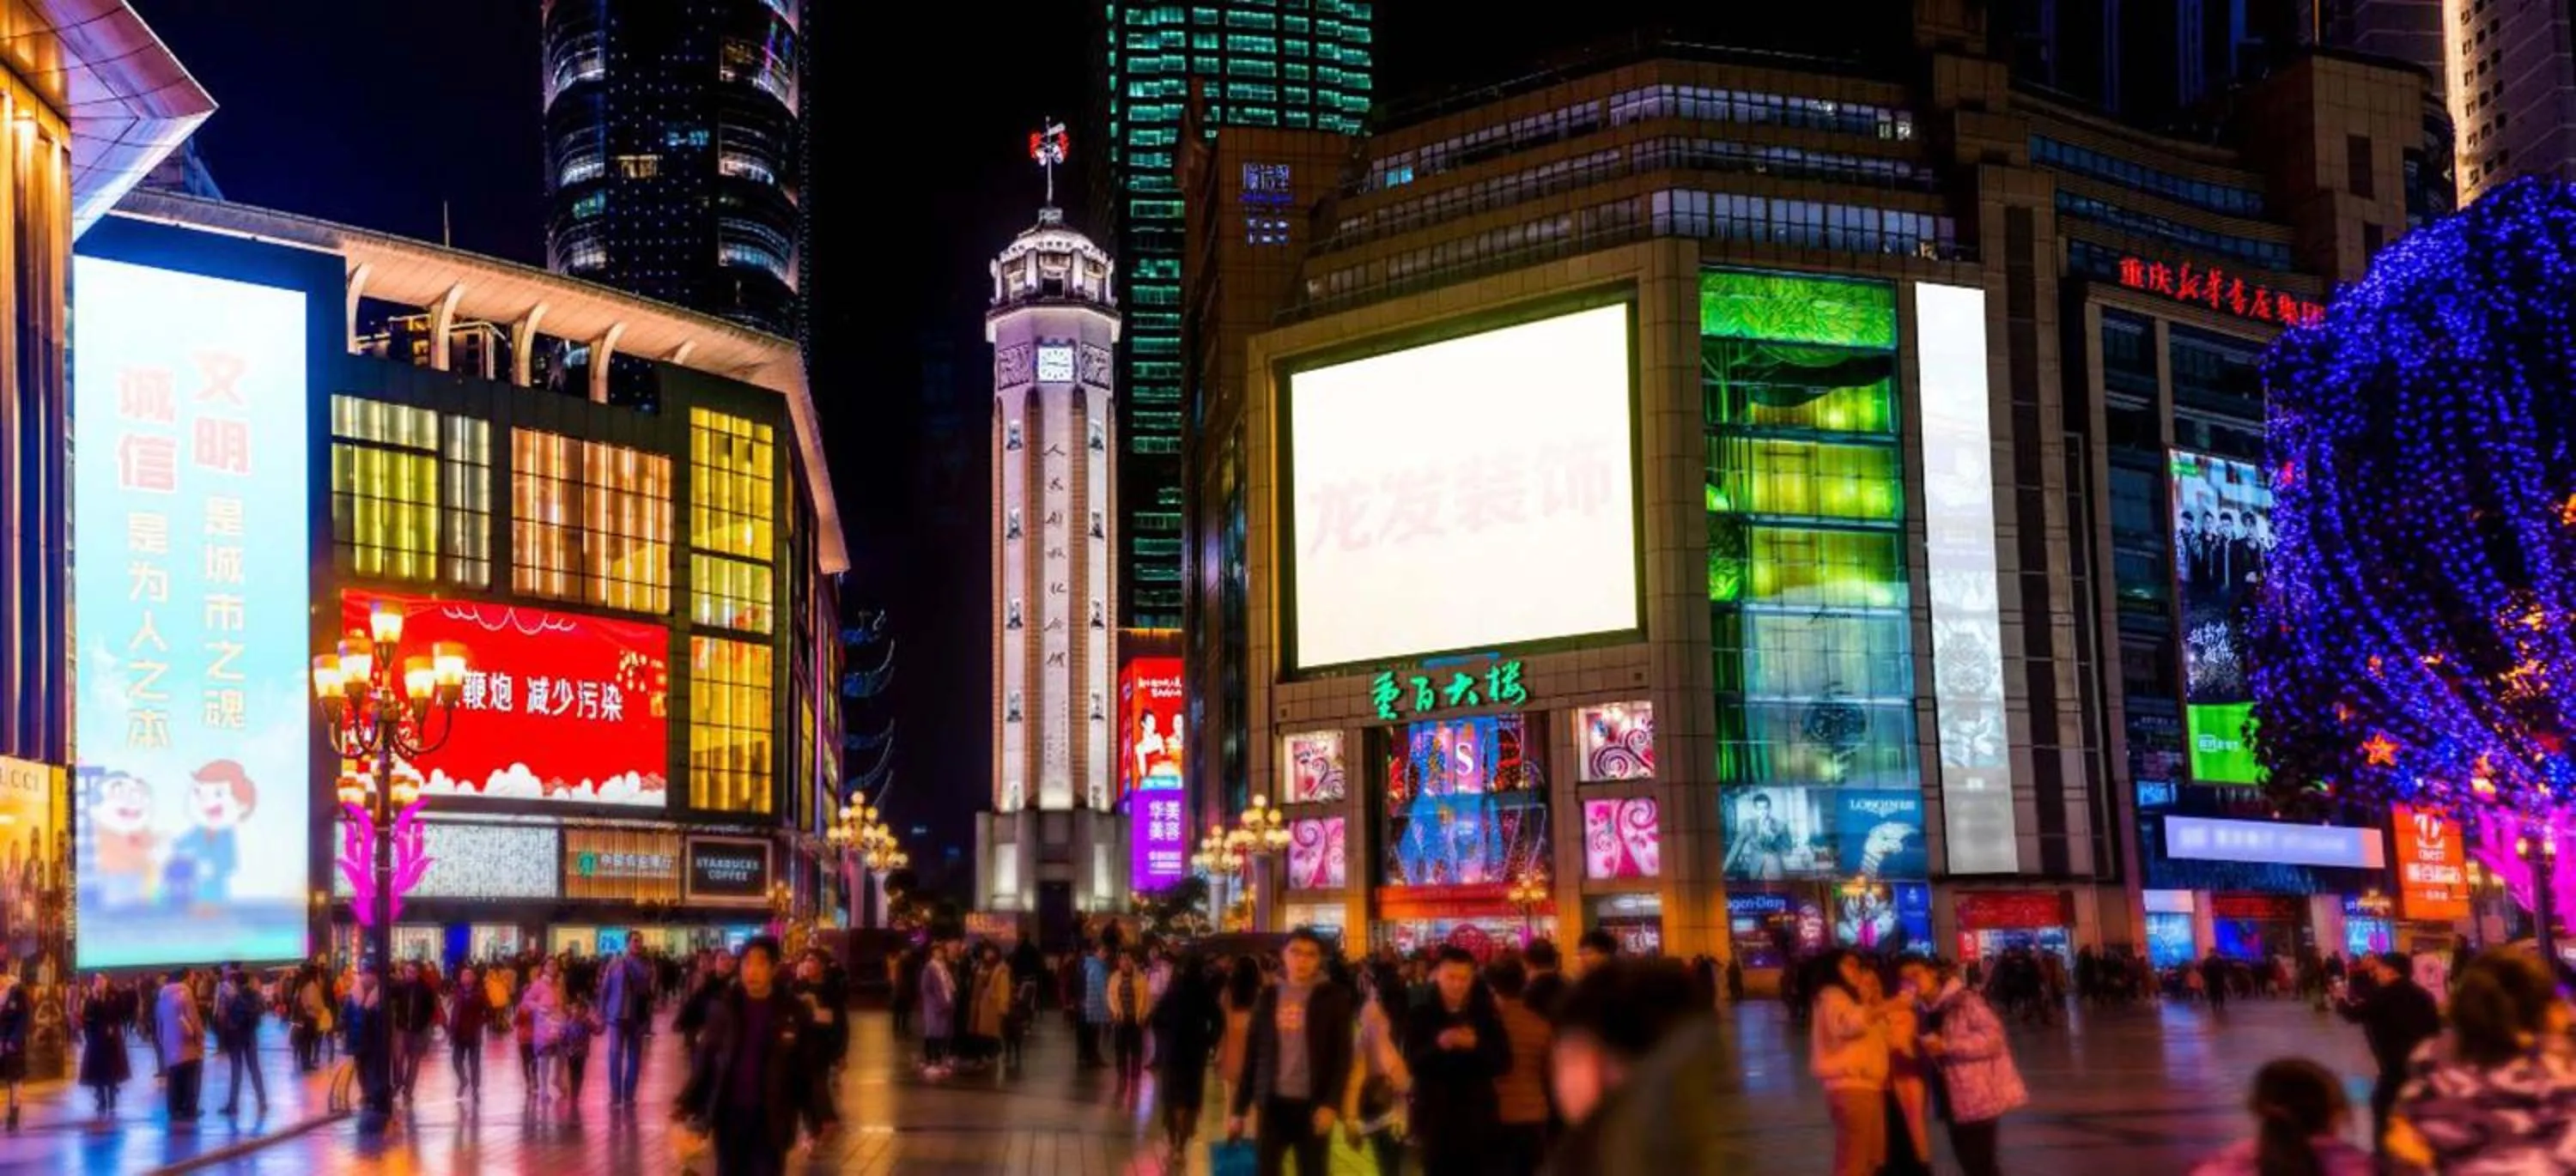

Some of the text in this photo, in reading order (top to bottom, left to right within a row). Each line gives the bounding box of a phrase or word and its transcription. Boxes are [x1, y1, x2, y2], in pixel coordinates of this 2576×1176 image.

[1309, 433, 1613, 560] 龙发装饰
[204, 495, 246, 728] 是城市之魂
[526, 676, 623, 722] 减少污染
[1372, 659, 1527, 720] 重百大楼
